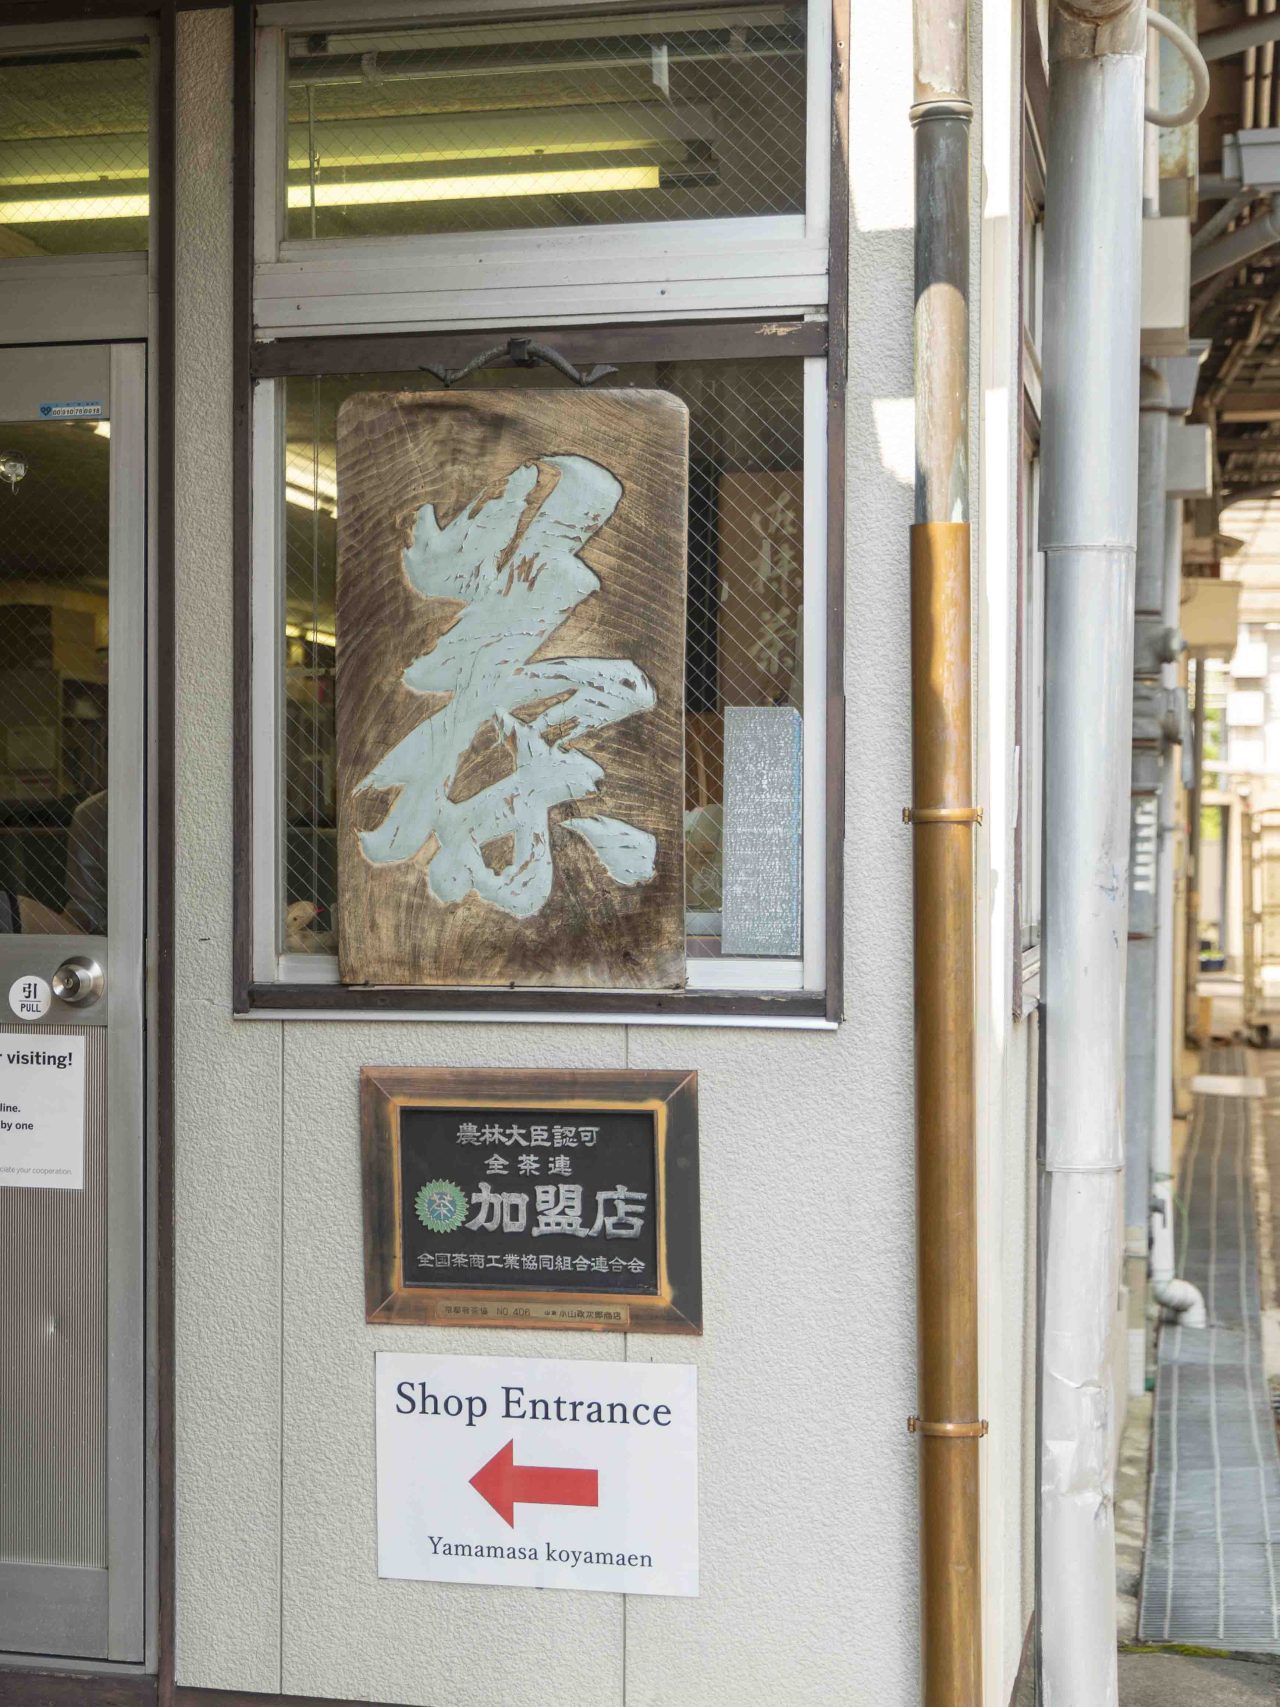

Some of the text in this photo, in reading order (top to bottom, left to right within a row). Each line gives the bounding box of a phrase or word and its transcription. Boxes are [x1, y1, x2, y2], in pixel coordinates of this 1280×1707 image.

[23, 983, 37, 999] 引
[20, 1003, 41, 1013] PULL
[7, 1051, 72, 1069] visiting!
[0, 1103, 21, 1112] line.
[1, 1120, 12, 1131] by
[15, 1122, 34, 1130] one
[456, 1123, 600, 1148] 農林大臣認可
[484, 1154, 573, 1176] 全茶連
[465, 1182, 648, 1240] 加盟店
[417, 1253, 645, 1273] 全国茶商工業協同組合連合会
[396, 1381, 672, 1426] Shop Entrance
[428, 1536, 653, 1568] Yamamasa koyamaen
